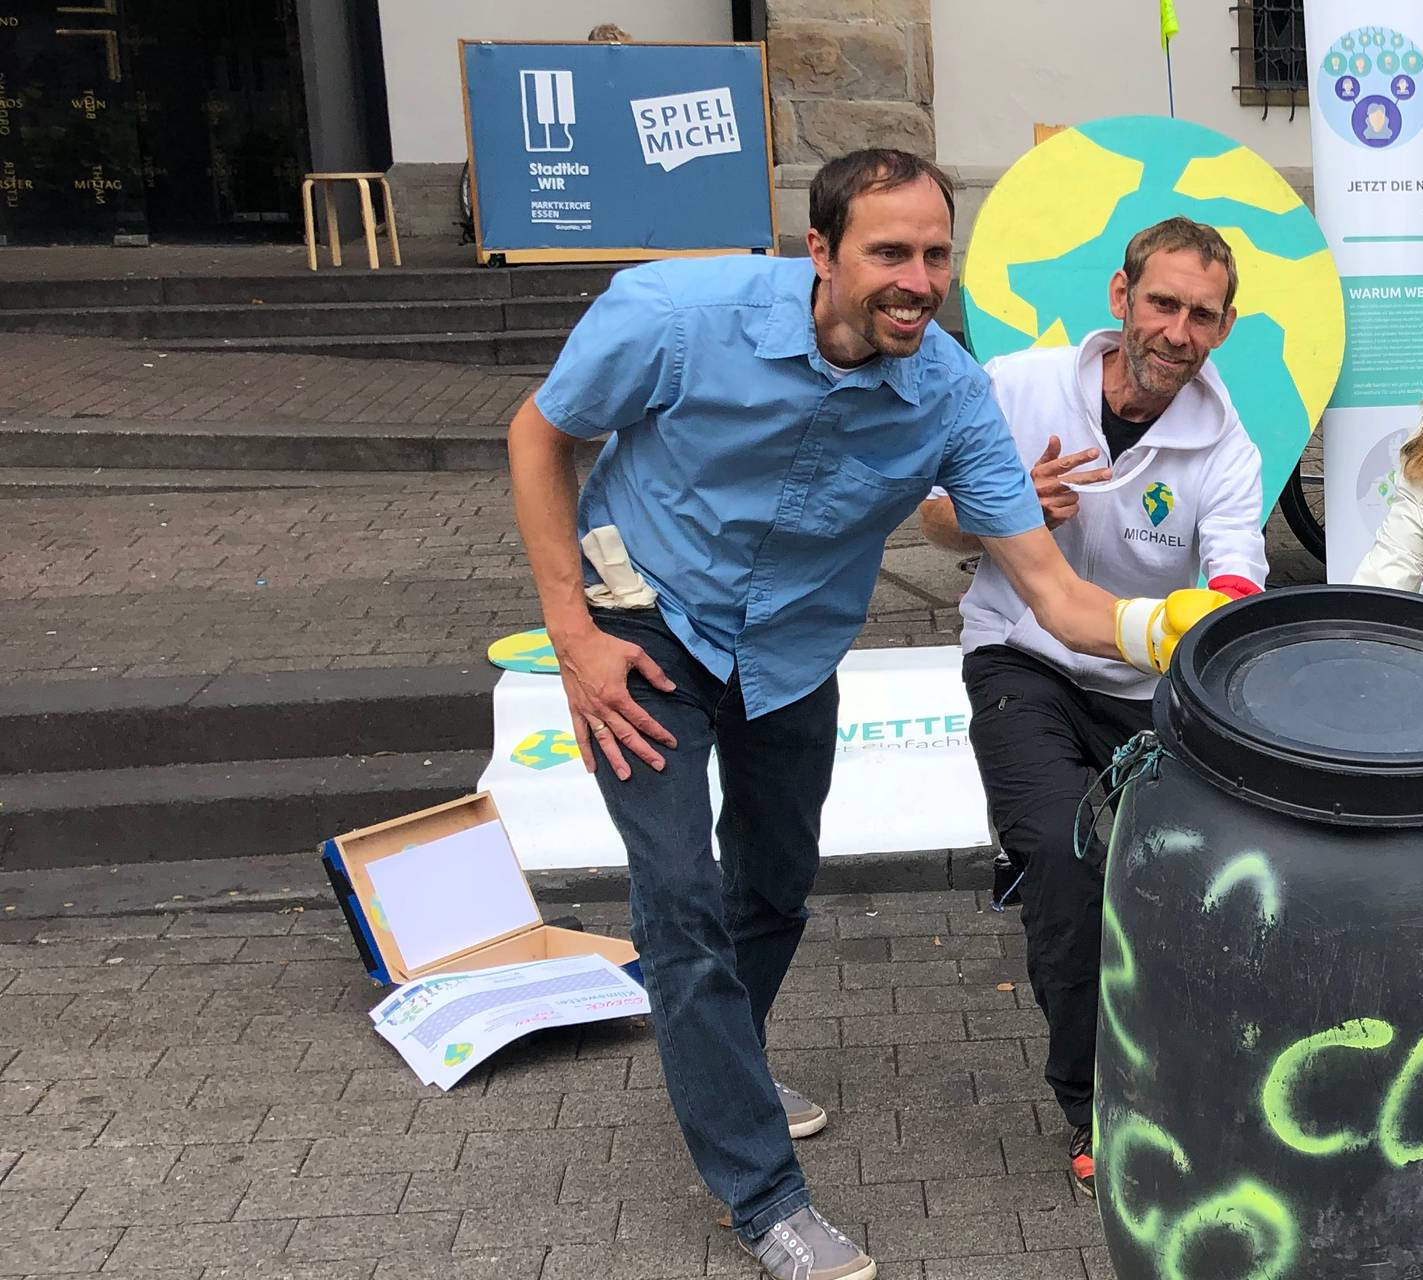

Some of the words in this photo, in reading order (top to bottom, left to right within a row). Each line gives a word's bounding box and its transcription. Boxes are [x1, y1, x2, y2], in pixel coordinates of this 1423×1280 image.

[640, 98, 731, 129] SPIEL
[645, 122, 736, 153] MICH!
[529, 162, 590, 176] Stadtkla
[74, 180, 122, 190] MITTAG
[1347, 180, 1387, 193] JETZT
[1391, 180, 1413, 192] DIE
[531, 201, 591, 210] MARKTKIRCHE
[531, 210, 560, 218] ESSEN
[1349, 287, 1401, 299] WARUM
[1124, 527, 1186, 547] MICHAEL
